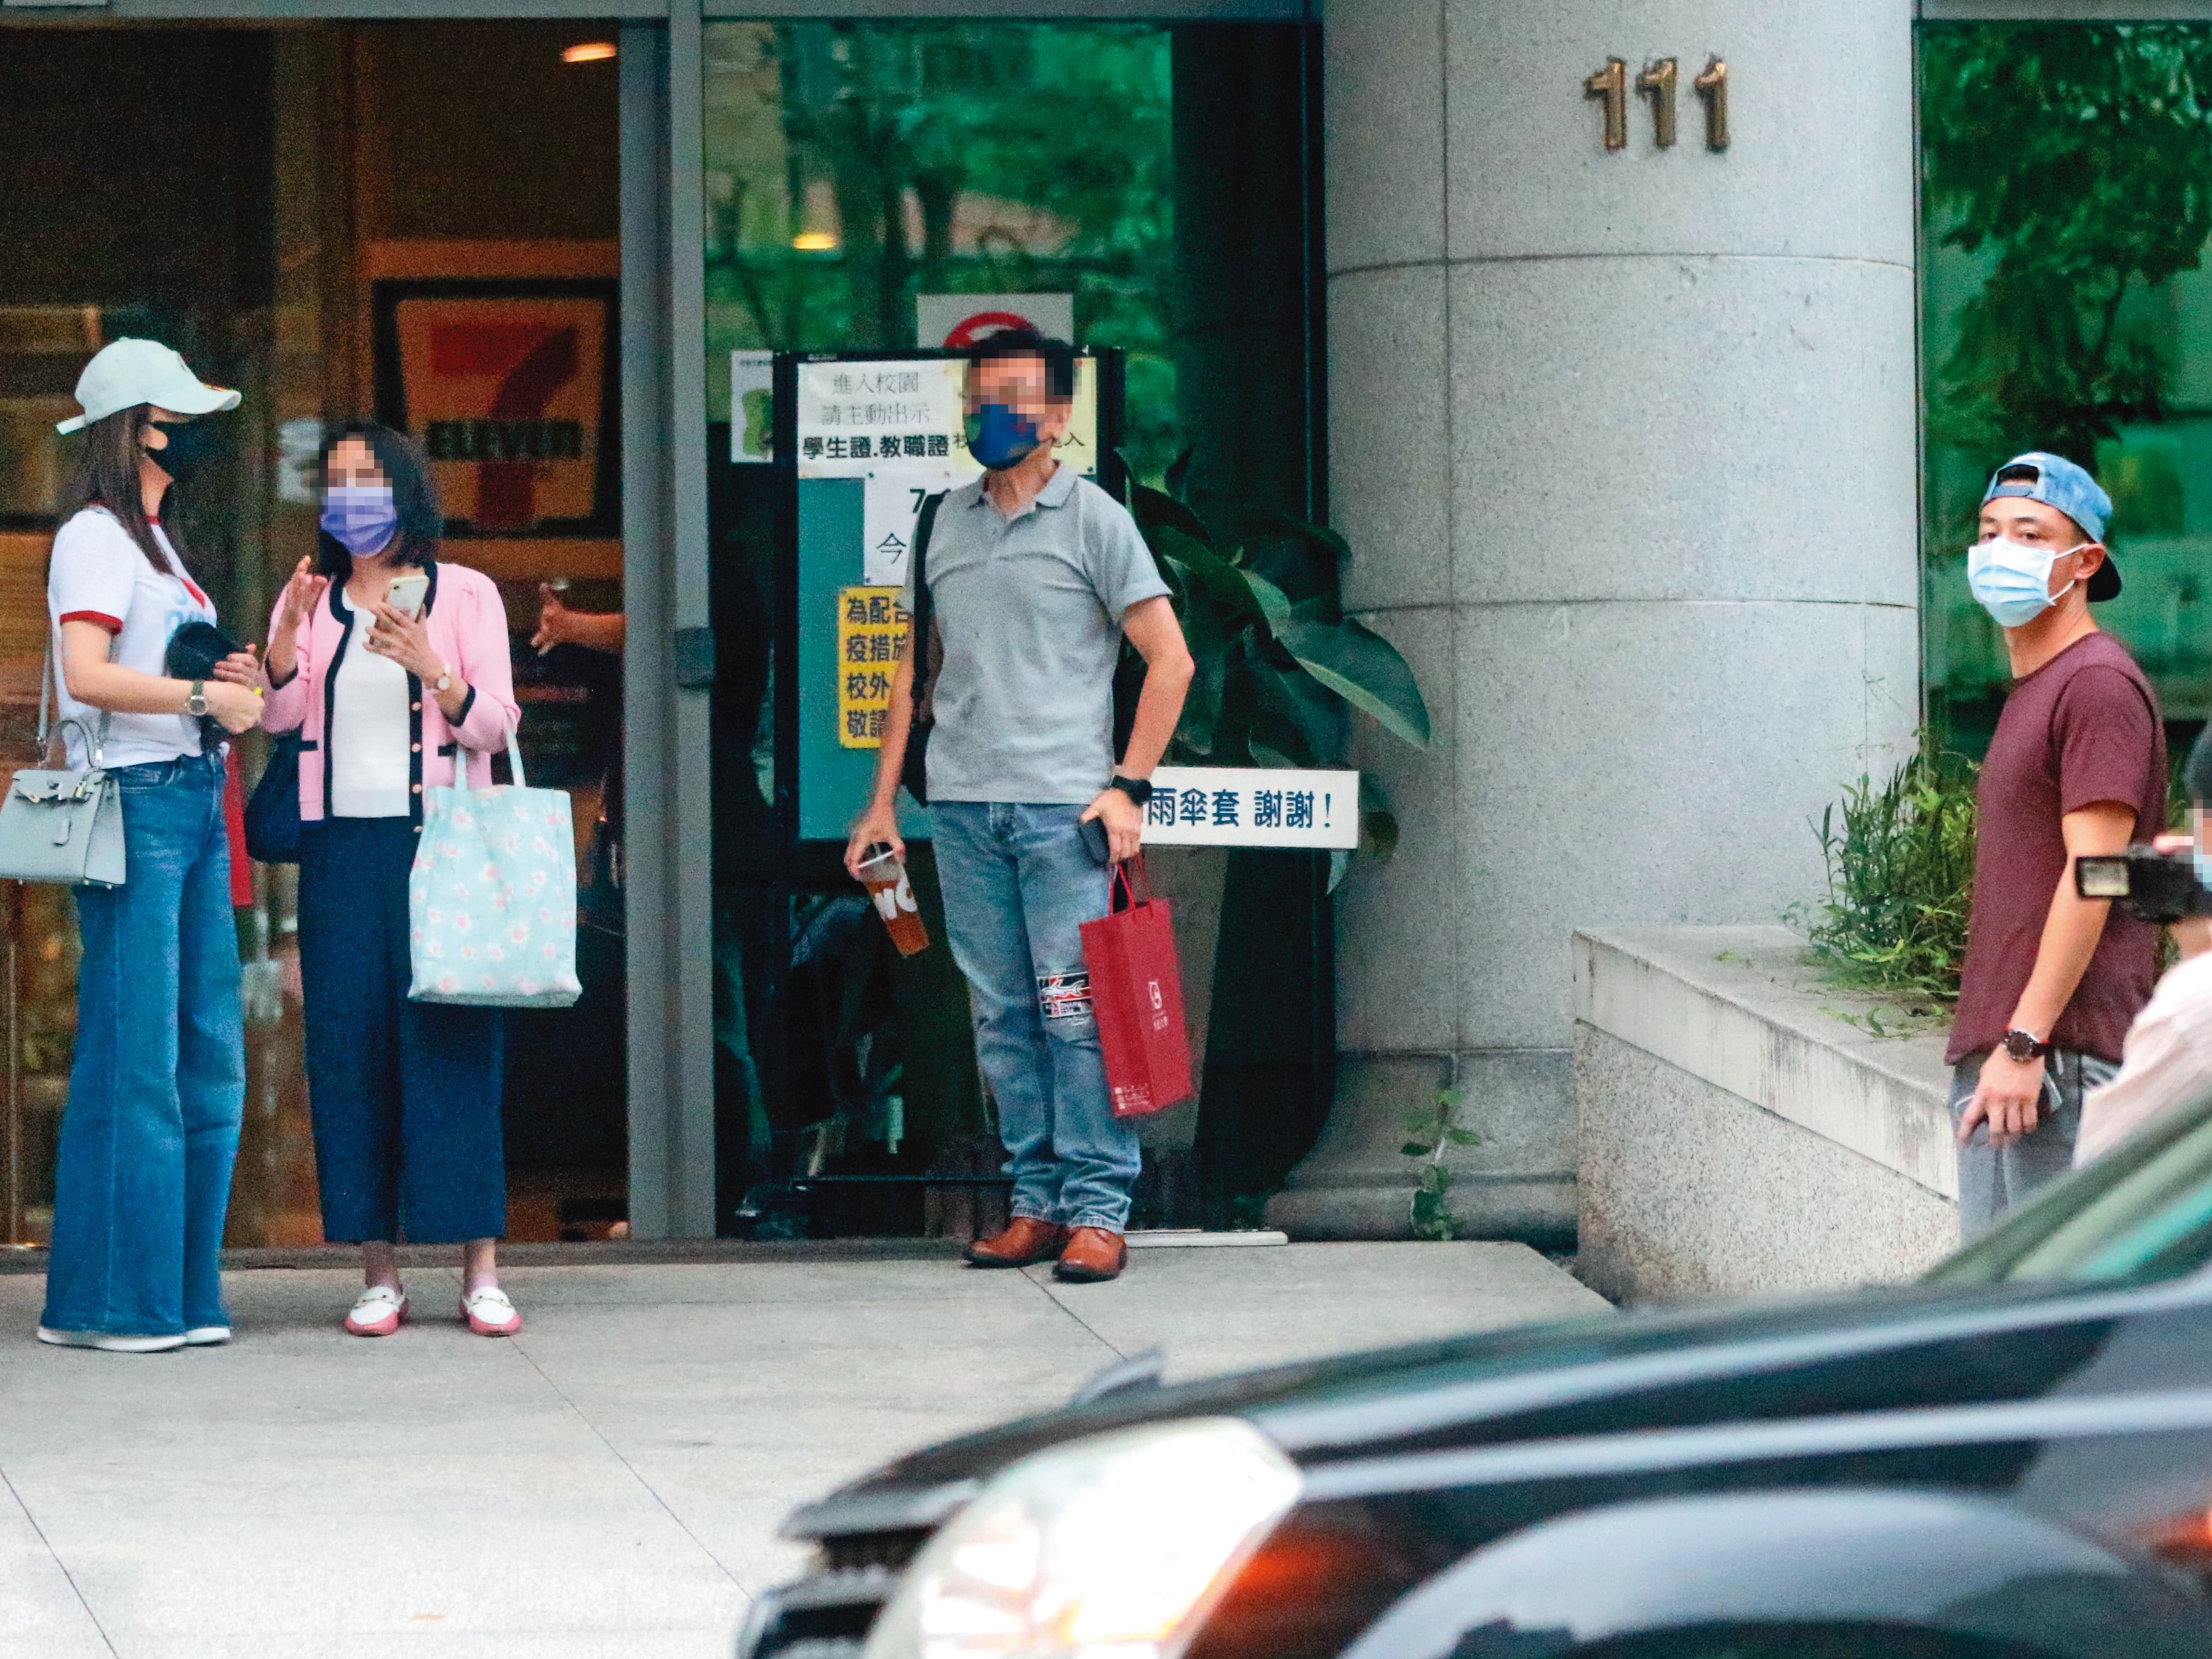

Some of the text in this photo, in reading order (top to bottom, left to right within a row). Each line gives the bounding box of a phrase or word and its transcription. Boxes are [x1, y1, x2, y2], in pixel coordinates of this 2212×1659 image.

[1583, 55, 1730, 152] 111
[832, 372, 919, 395] 進入校園
[821, 402, 930, 425] 請主動出示
[876, 533, 907, 565] 今
[847, 671, 891, 701] 校外
[1148, 787, 1240, 828] 雨傘套
